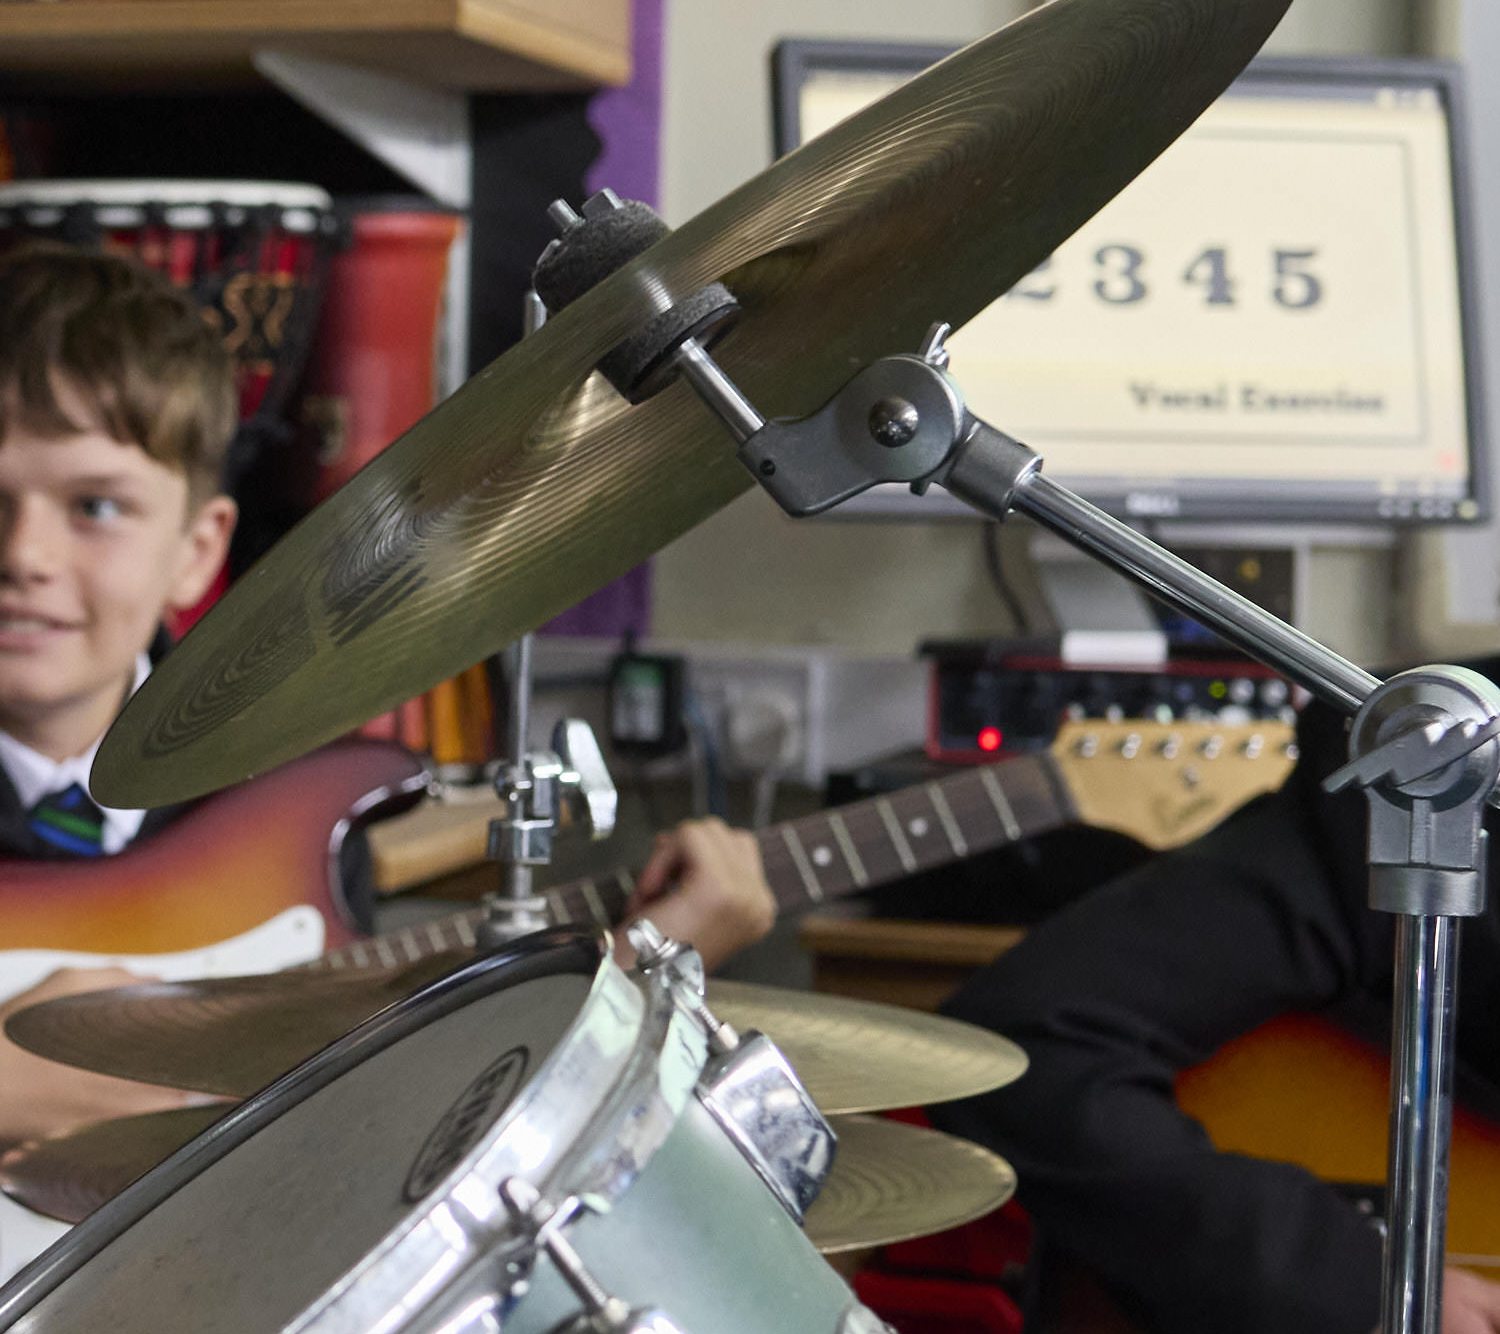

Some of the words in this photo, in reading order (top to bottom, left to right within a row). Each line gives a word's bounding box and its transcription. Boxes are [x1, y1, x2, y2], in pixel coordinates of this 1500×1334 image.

[1093, 244, 1149, 306] 3
[1182, 246, 1238, 307] 4
[1273, 248, 1323, 309] 5
[1130, 384, 1228, 411] Vocal
